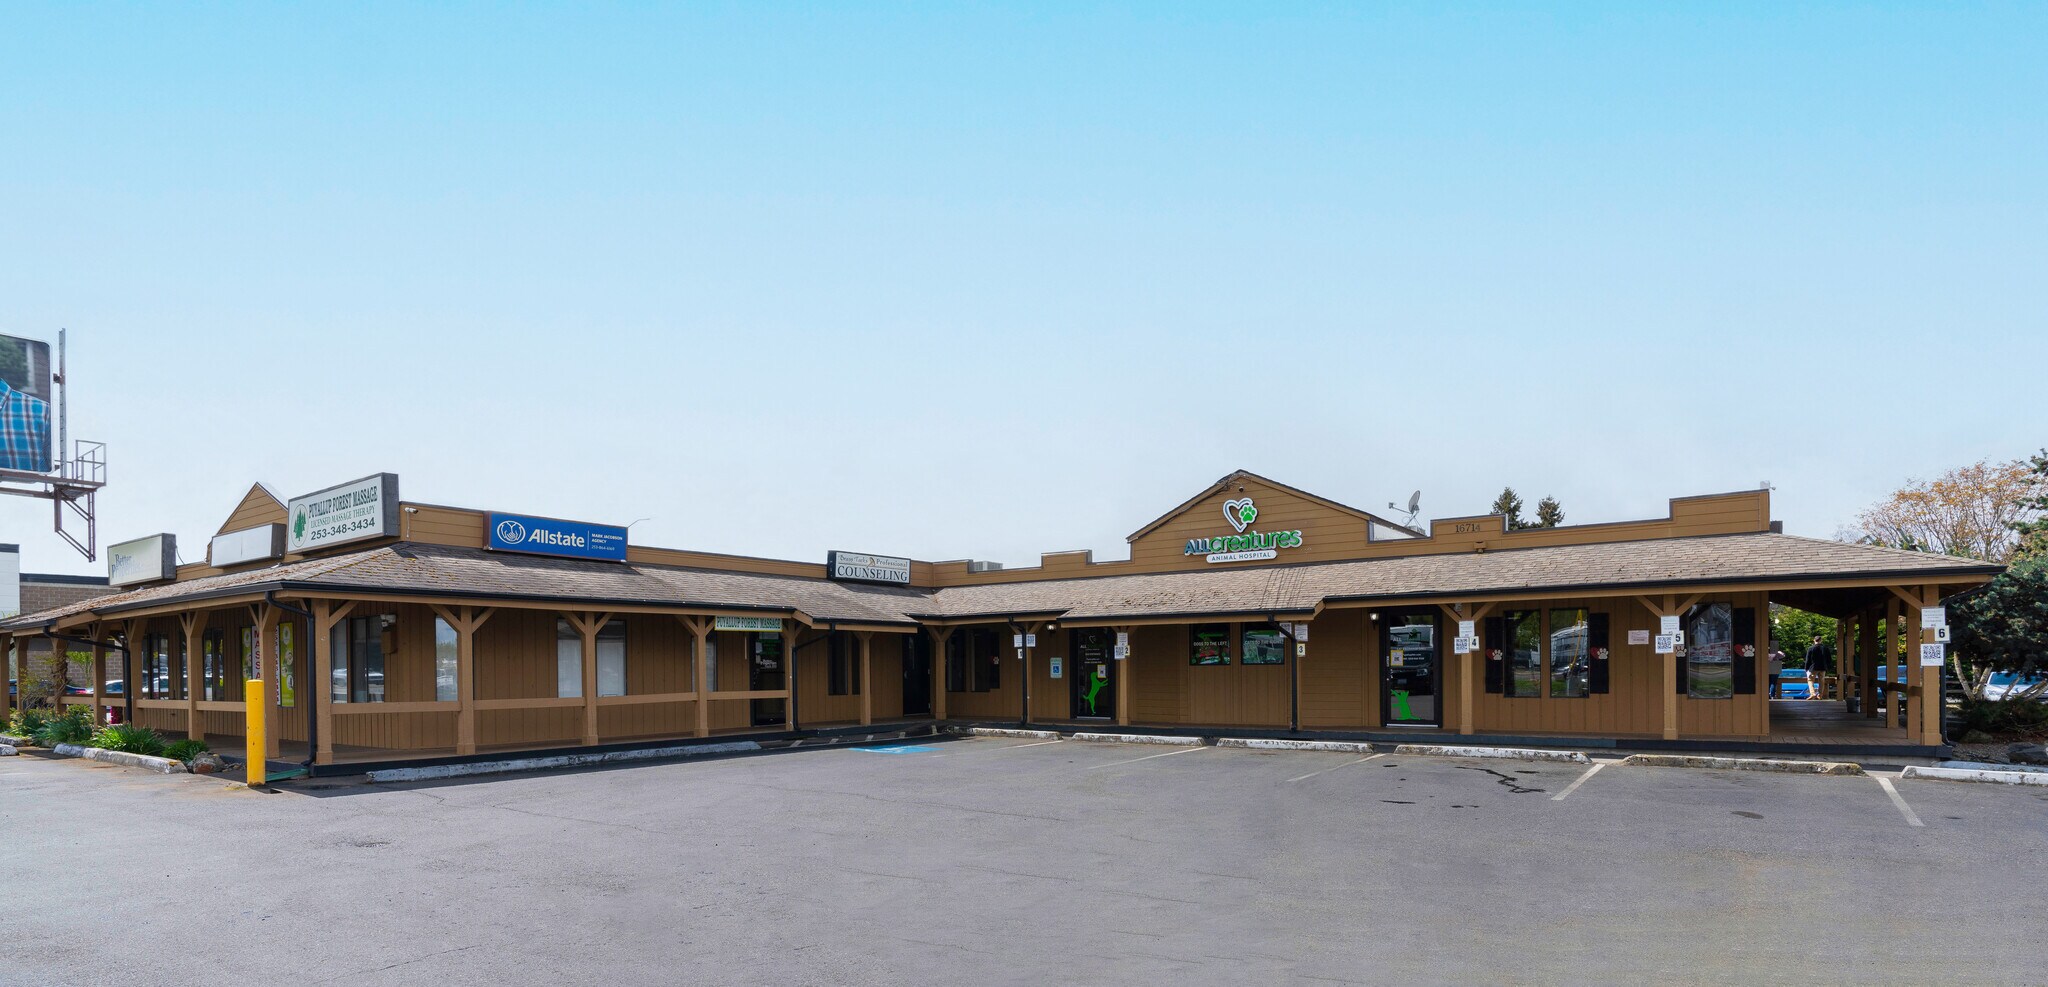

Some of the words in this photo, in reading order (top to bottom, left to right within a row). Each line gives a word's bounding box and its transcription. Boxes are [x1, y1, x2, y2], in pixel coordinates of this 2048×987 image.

[308, 499, 332, 519] PUYALLUP
[332, 492, 352, 513] FOREST
[352, 485, 378, 507] MASSAGE
[310, 516, 331, 529] LICENSED
[331, 510, 352, 523] MASSAGE
[353, 504, 376, 518] THERAPY
[310, 517, 376, 541] 253-348-3434
[528, 528, 585, 548] Allstate
[876, 558, 908, 568] Professional
[837, 566, 908, 582] COUNSELING
[1676, 634, 1680, 642] 5
[1938, 628, 1946, 638] 6
[1472, 638, 1476, 646] 4
[1125, 646, 1129, 654] 2
